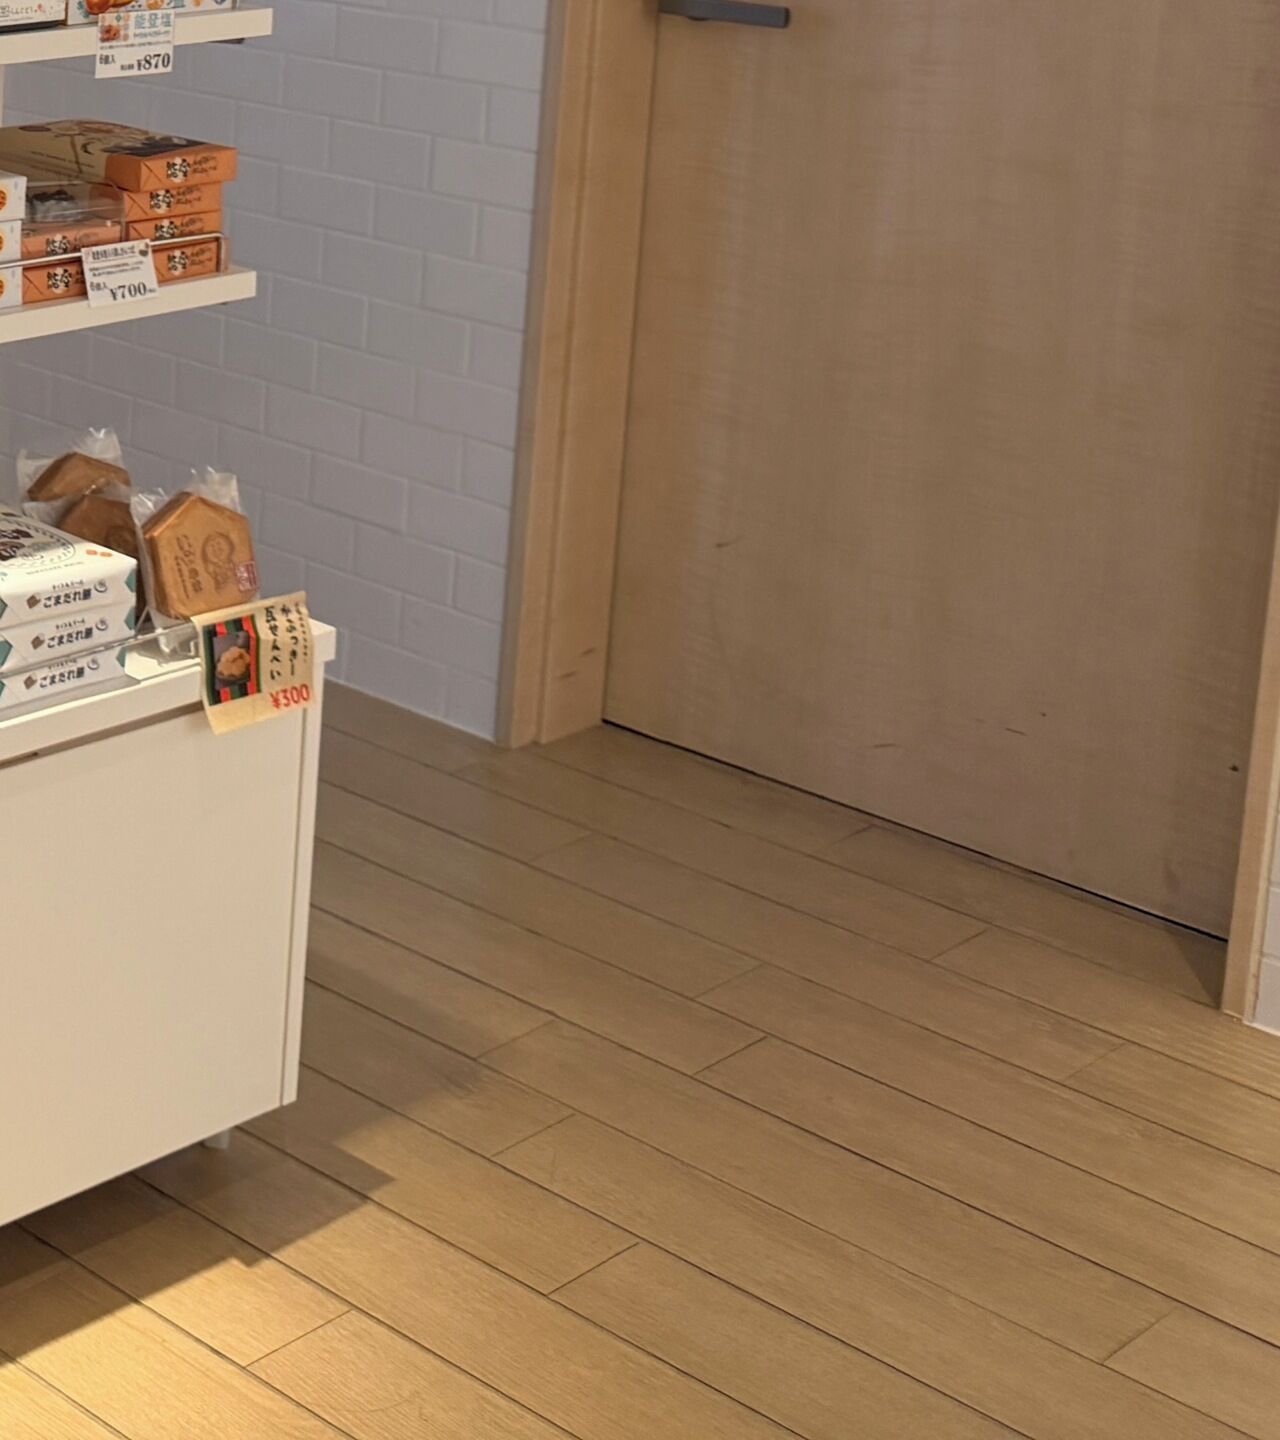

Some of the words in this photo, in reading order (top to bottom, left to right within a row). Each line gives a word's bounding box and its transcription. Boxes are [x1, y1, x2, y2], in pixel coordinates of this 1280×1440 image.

[136, 52, 171, 71] ¥870
[110, 282, 147, 301] ¥700
[270, 683, 310, 709] ¥300
